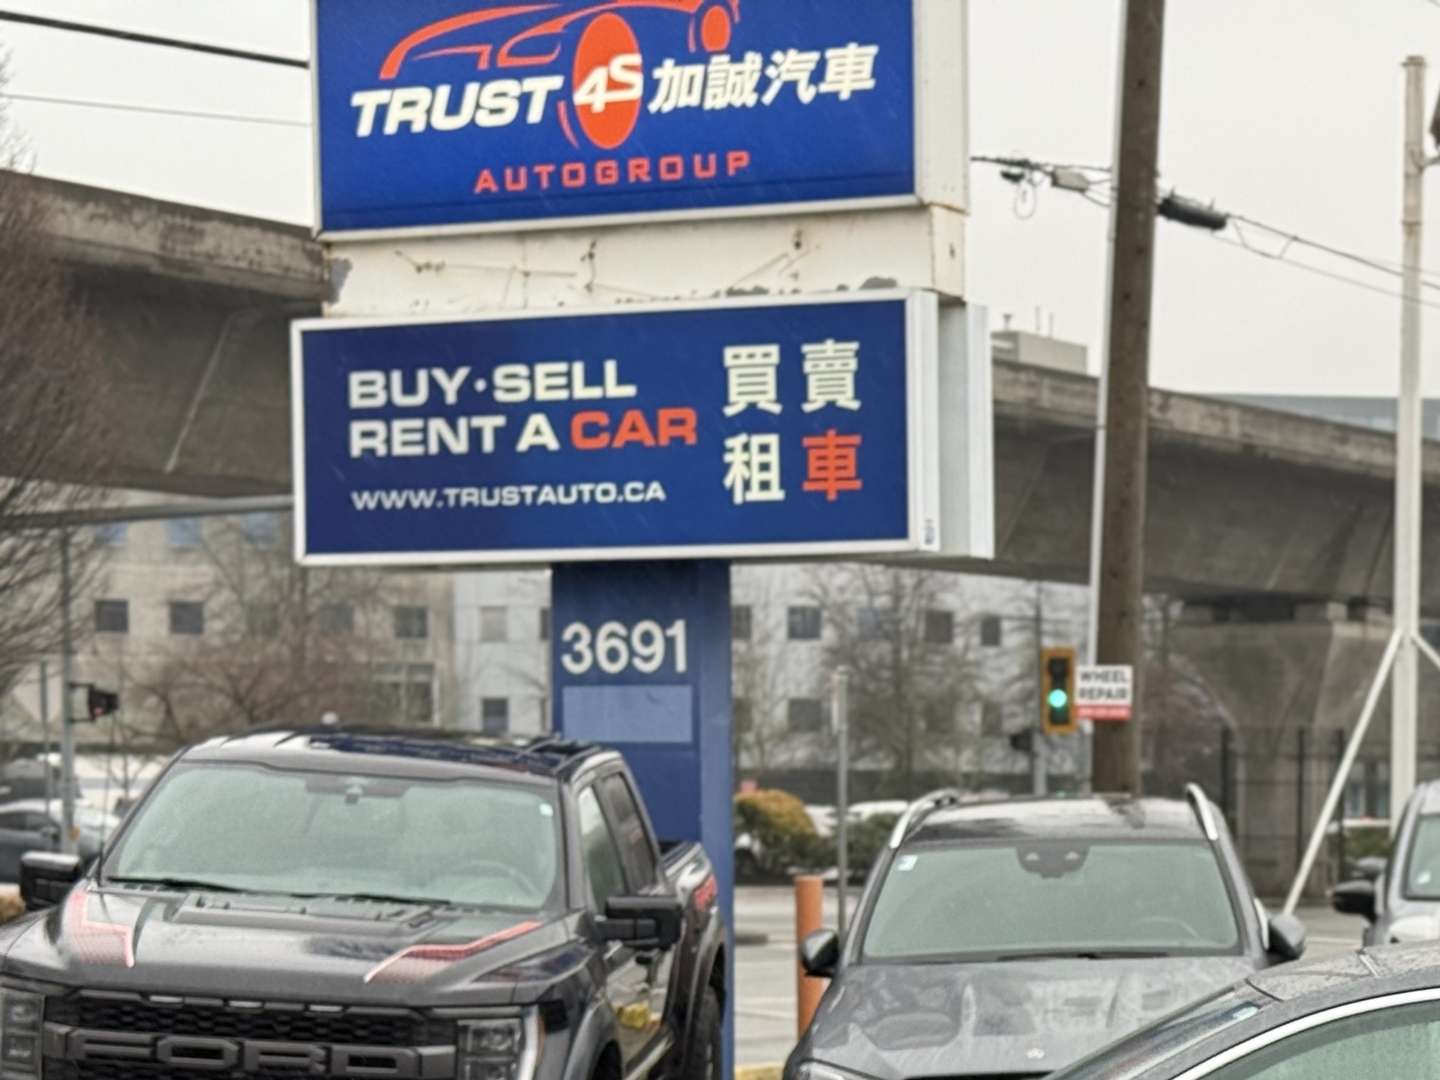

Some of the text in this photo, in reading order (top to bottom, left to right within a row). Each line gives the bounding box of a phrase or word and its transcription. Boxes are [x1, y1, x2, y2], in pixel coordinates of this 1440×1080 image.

[350, 75, 564, 137] TRUST
[648, 42, 879, 115] 加誠汽車
[474, 150, 751, 194] AUTOGROUP
[348, 407, 698, 458] RENT A CAR
[351, 481, 667, 511] WWW.TRUSTAUTO.CA
[561, 619, 688, 674] 3691
[1079, 687, 1127, 700] REPAIR
[1080, 670, 1128, 682] WHEEL
[65, 1028, 419, 1079] FORD
